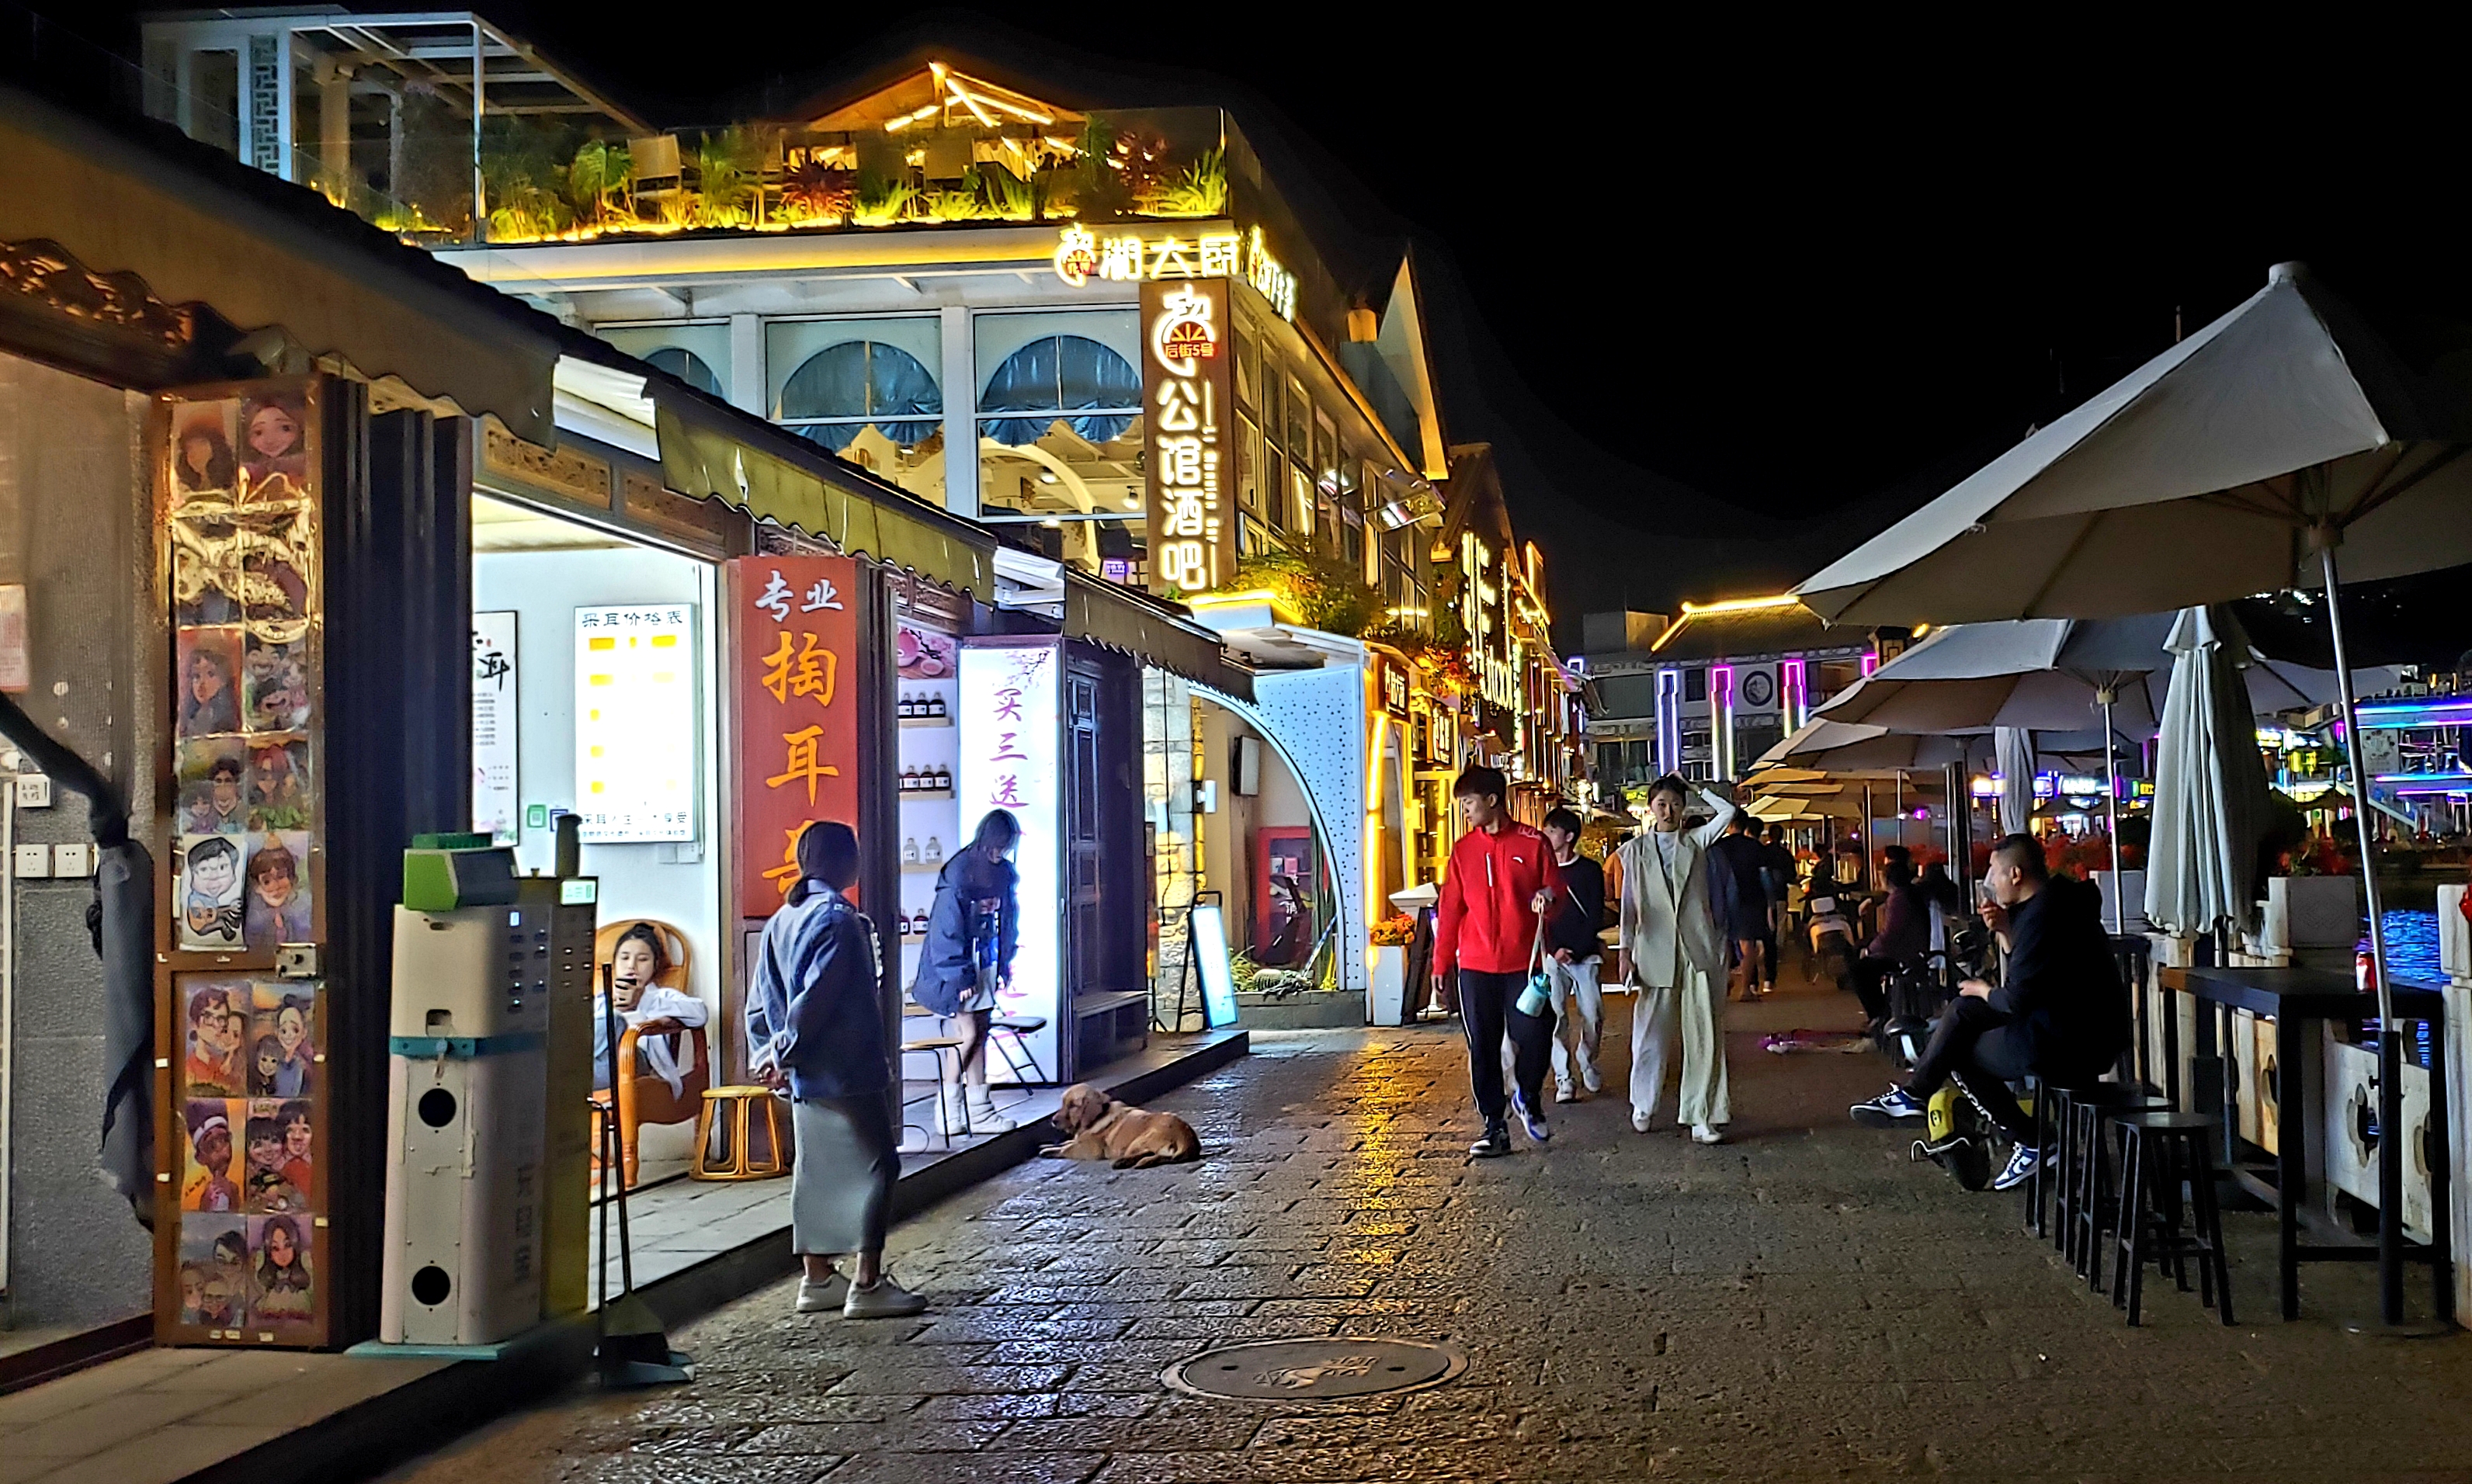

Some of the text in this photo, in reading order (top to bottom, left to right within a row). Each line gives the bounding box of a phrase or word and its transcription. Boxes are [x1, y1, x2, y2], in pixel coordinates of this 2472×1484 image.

[1165, 344, 1214, 359] 后街5号
[1156, 380, 1207, 590] 公馆酒吧
[755, 570, 843, 622] 专业
[582, 610, 683, 628] 采耳价格表
